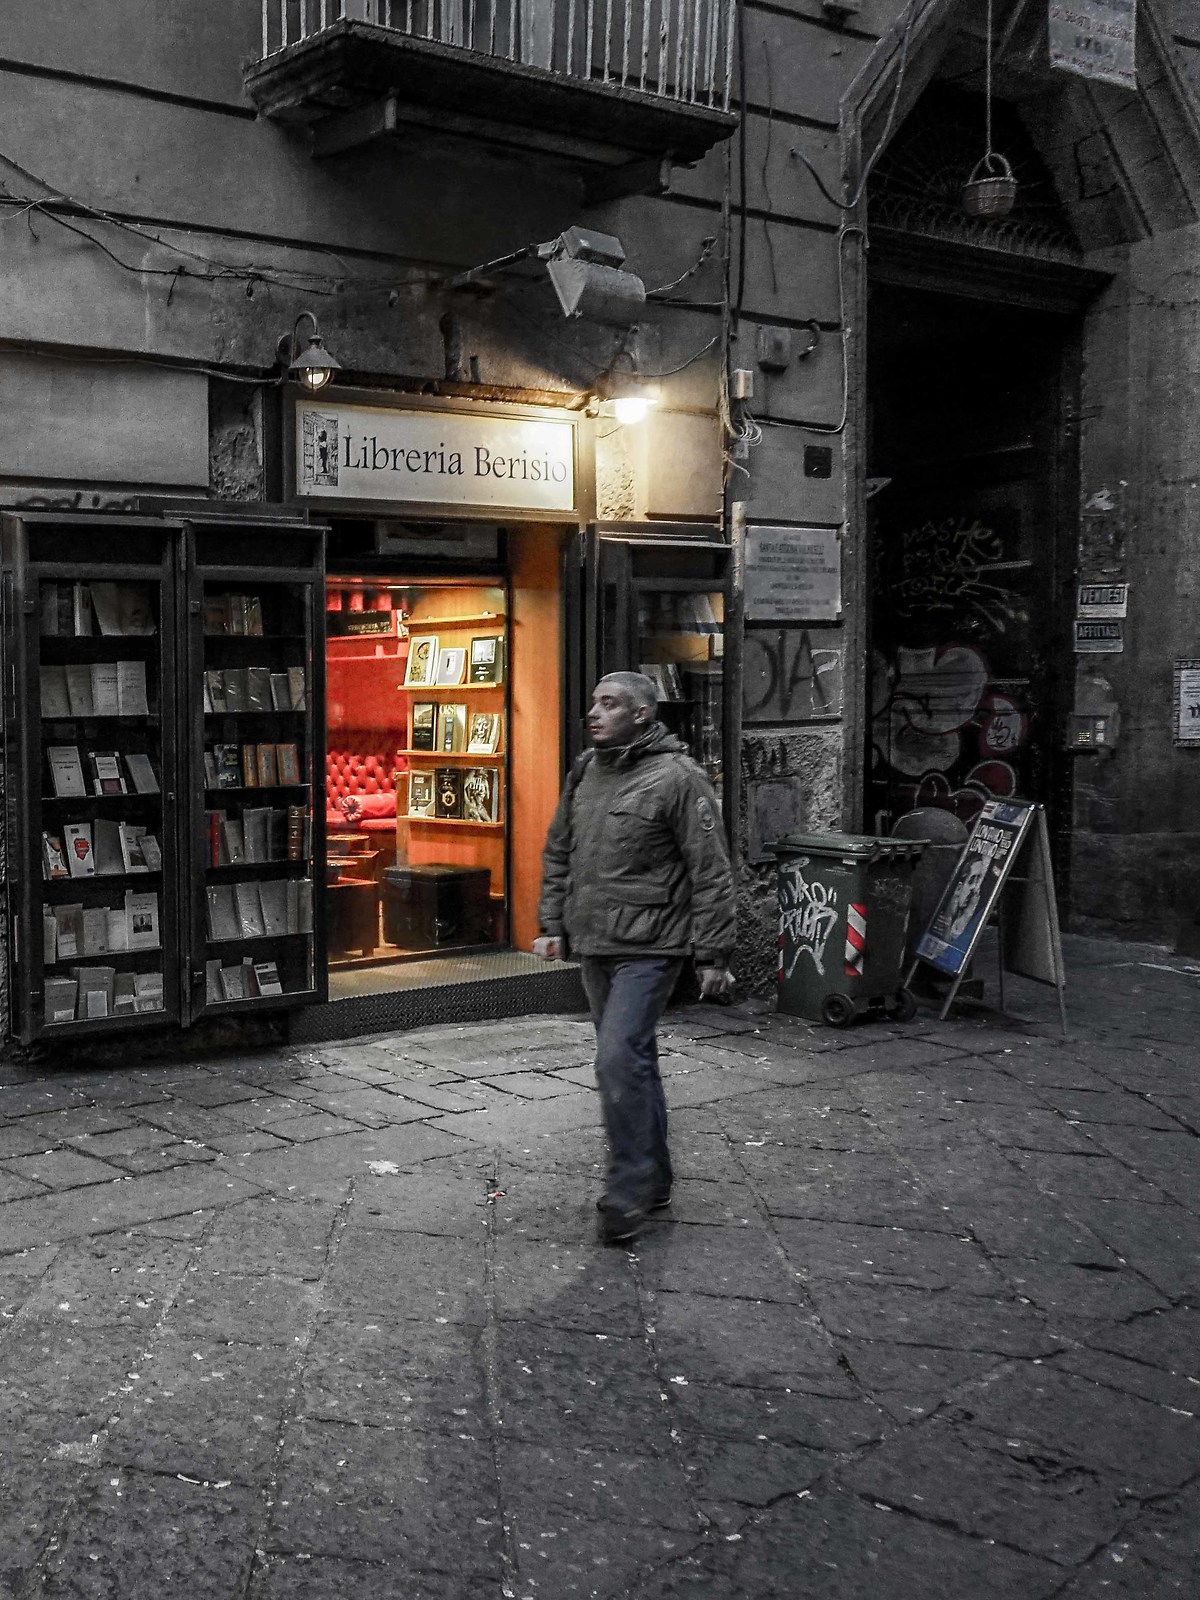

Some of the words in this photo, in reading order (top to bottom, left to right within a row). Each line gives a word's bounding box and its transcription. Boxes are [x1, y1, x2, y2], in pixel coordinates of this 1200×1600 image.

[342, 435, 464, 475] Libreria
[473, 446, 567, 483] Berisio
[1081, 588, 1124, 604] VENDESI
[1077, 624, 1121, 638] AFFITTASI
